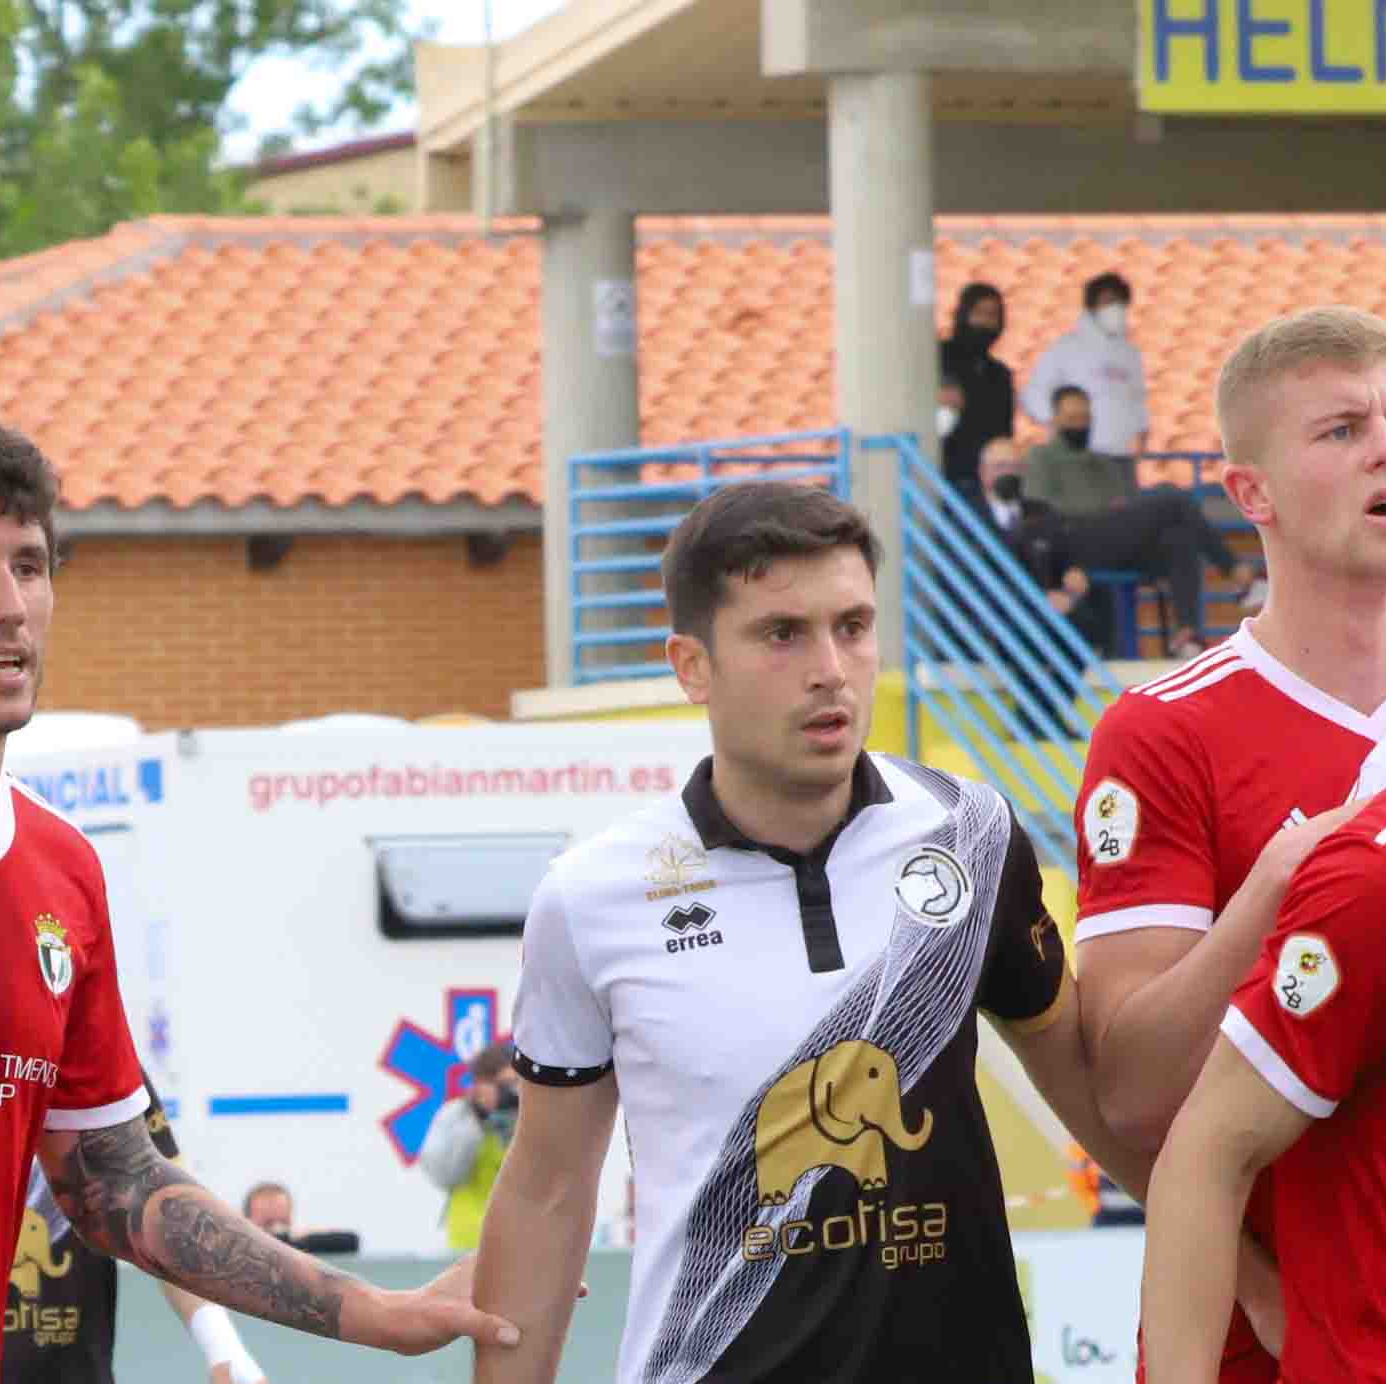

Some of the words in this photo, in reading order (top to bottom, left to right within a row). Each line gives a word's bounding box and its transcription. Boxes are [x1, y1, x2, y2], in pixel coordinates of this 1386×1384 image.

[246, 761, 677, 813] grupofabianmartin.es
[666, 929, 724, 954] errea
[882, 1242, 945, 1270] grupo
